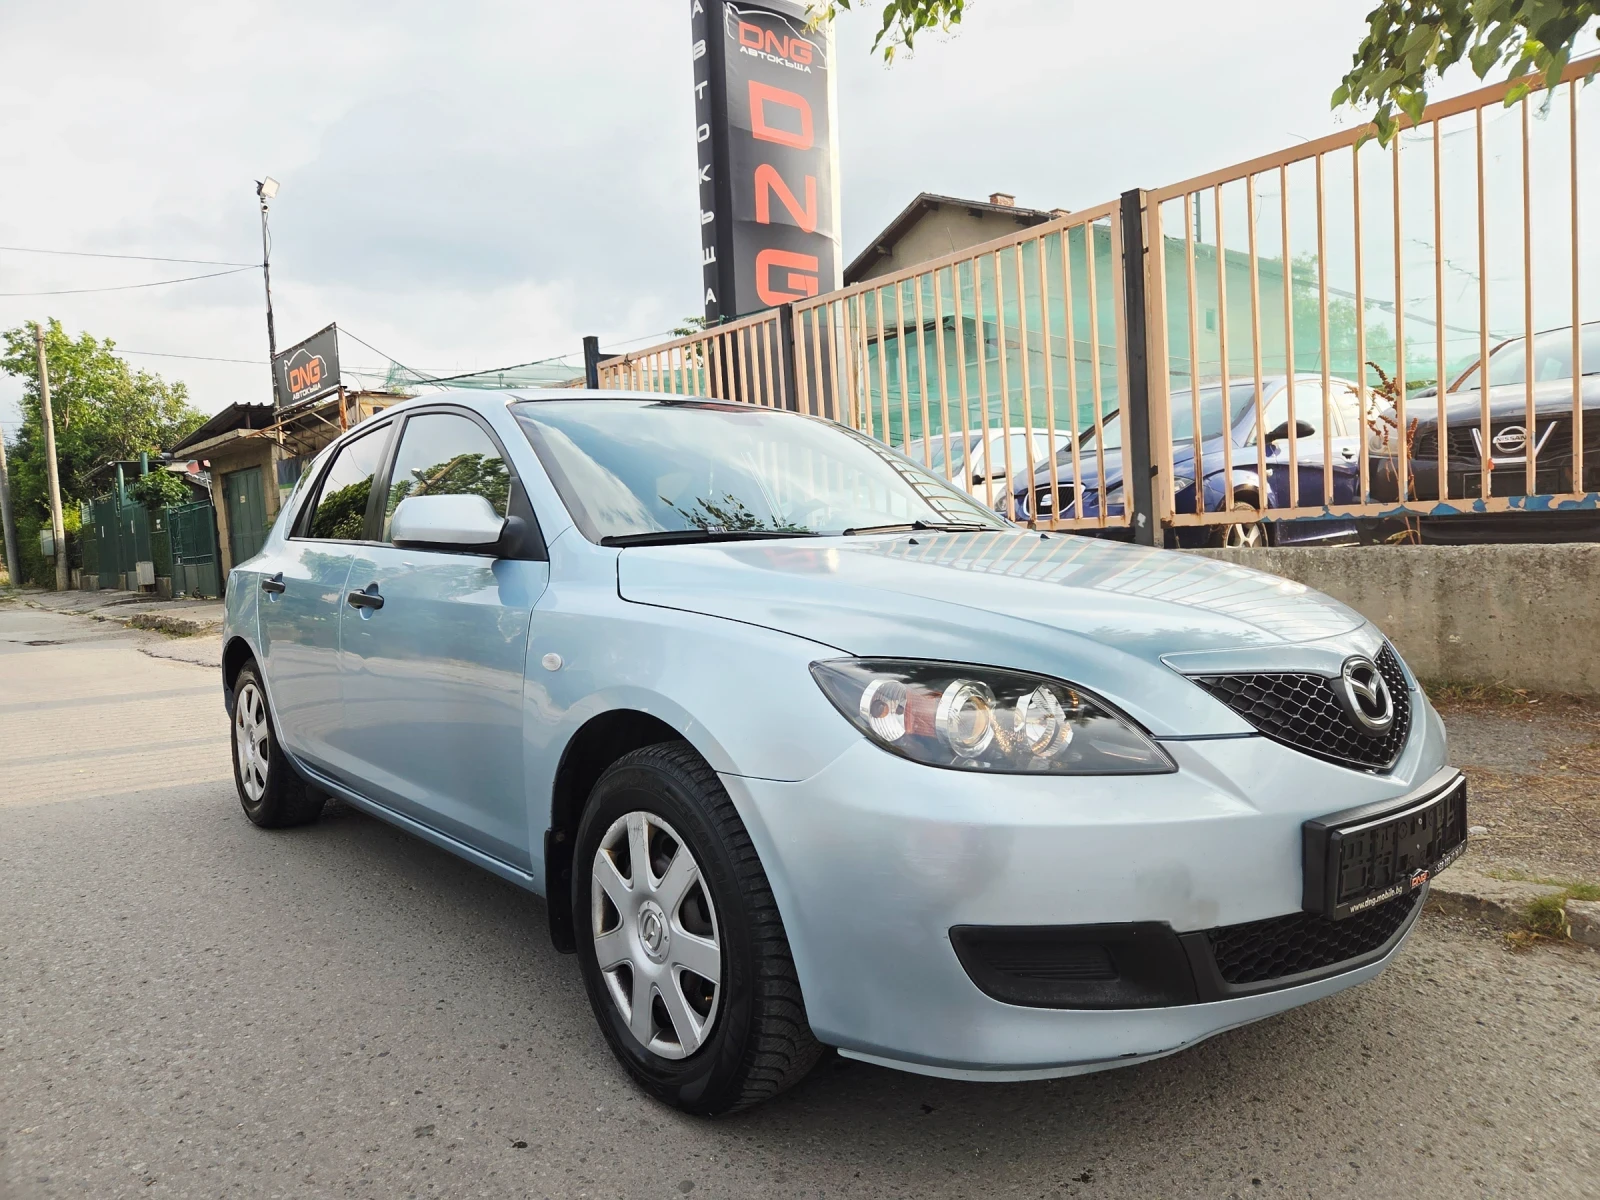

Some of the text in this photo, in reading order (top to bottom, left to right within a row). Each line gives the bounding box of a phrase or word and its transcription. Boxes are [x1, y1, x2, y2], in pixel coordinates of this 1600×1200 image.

[739, 21, 813, 65] DNG
[748, 79, 818, 307] DNG
[290, 358, 321, 393] DNG
[1349, 885, 1403, 913] www.dng.mobile.bg
